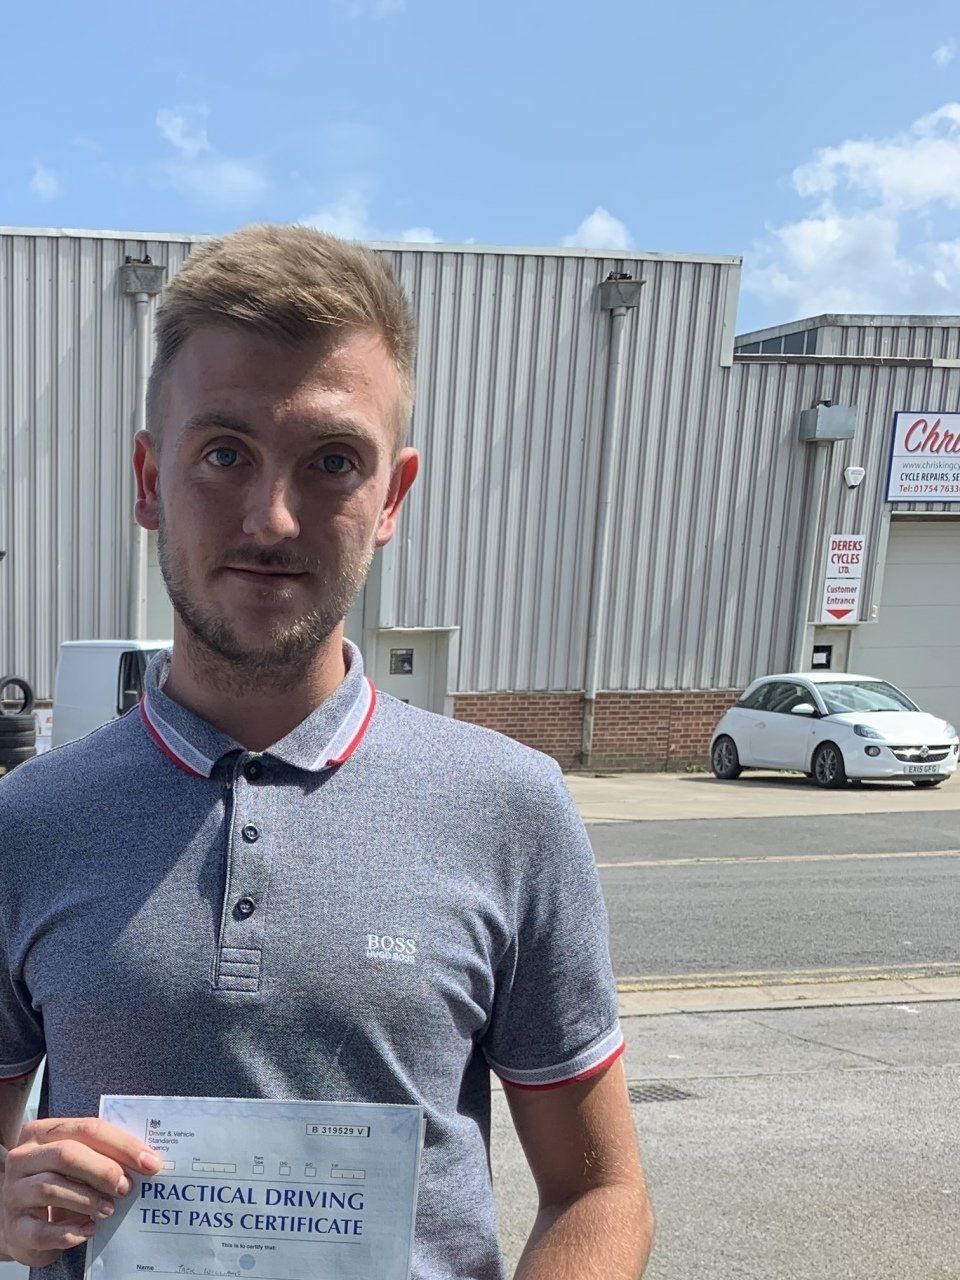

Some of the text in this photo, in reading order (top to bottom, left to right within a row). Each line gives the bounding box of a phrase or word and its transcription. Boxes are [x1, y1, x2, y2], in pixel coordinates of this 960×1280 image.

[900, 472, 920, 481] CYCLE
[921, 472, 950, 482] REPAIRS,
[914, 485, 938, 493] 01754
[832, 540, 863, 551] DEREKS
[831, 554, 860, 564] CYCLES
[827, 584, 858, 594] Customer
[827, 596, 856, 605] Entrance
[366, 934, 418, 954] BOSS
[322, 1127, 354, 1135] 319529
[148, 1137, 179, 1145] Standards
[140, 1182, 365, 1211] PRACTICAL DRIVING
[140, 1208, 364, 1236] TEST PASS CERTIFICATE
